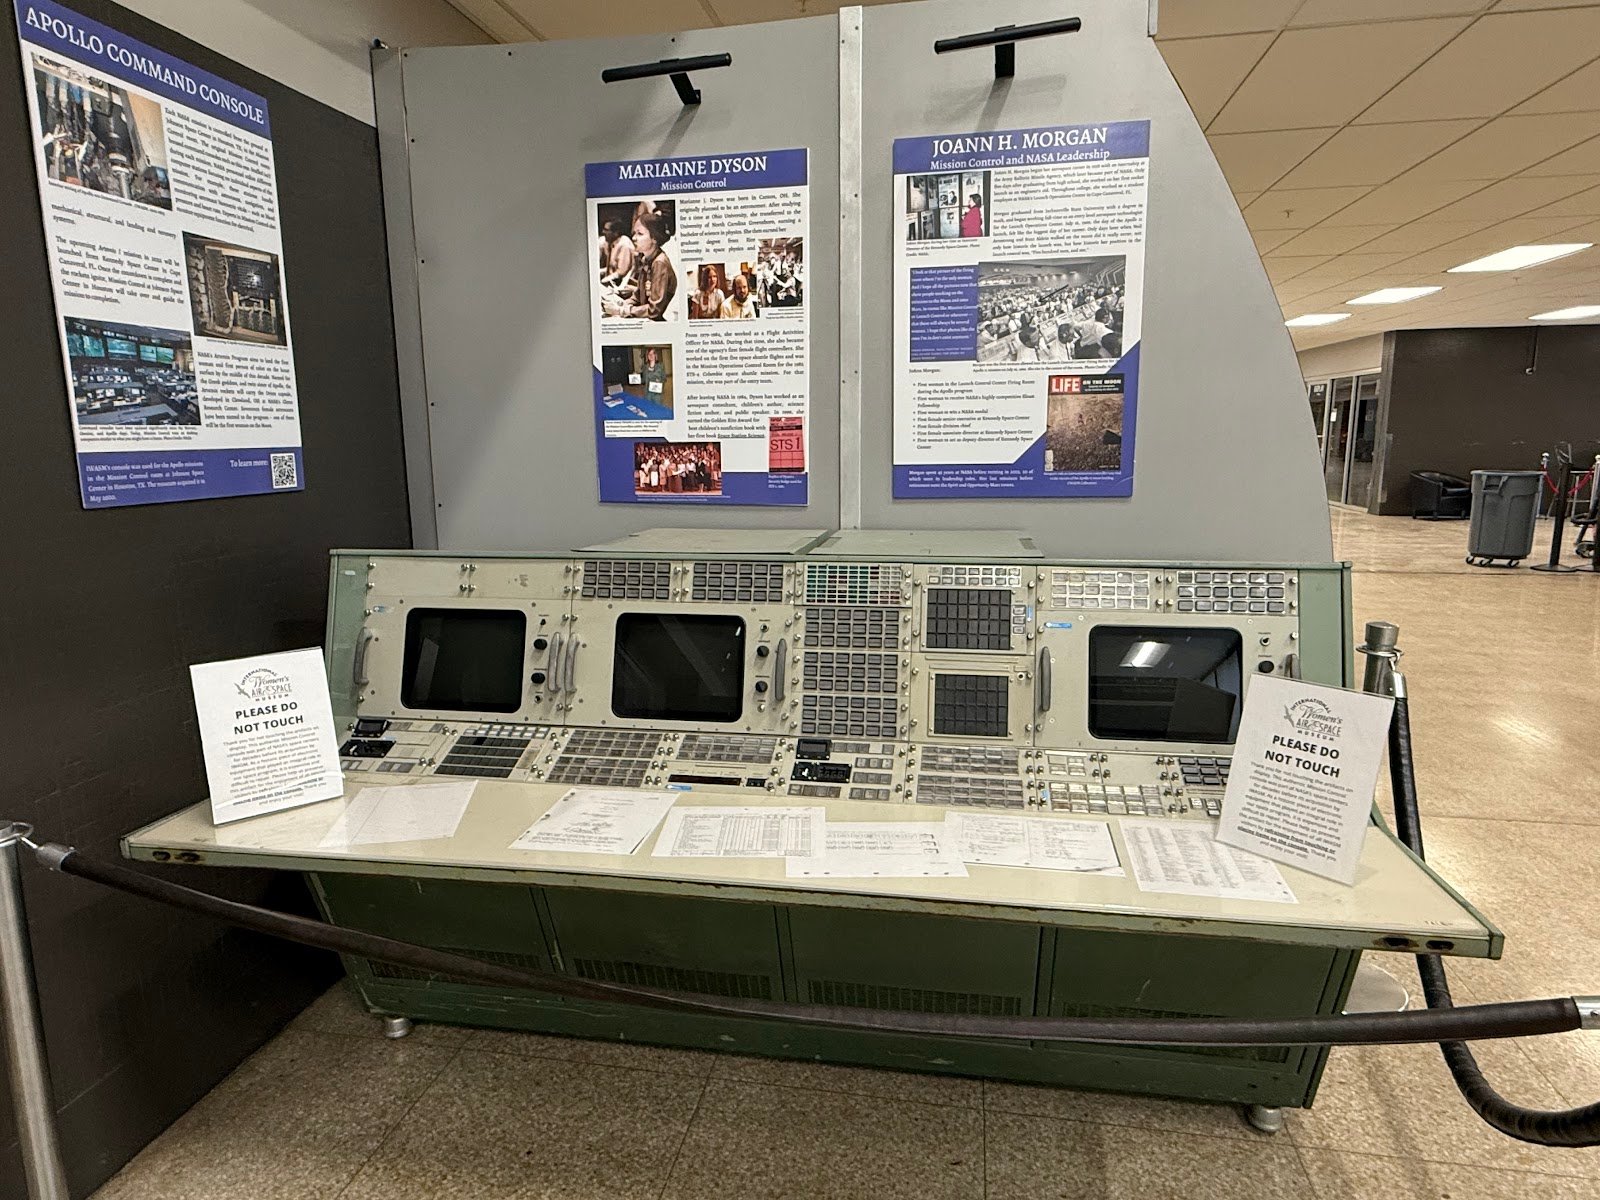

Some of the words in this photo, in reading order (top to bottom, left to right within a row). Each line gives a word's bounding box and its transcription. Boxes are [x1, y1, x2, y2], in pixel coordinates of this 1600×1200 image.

[26, 7, 103, 54] APOLLO
[107, 43, 196, 95] COMMAND
[199, 84, 264, 125] CONSOLE
[932, 137, 992, 158] JOANN
[997, 134, 1017, 150] H.
[1022, 127, 1108, 148] MORGAN
[619, 159, 707, 180] MARIANNE
[710, 156, 768, 175] DYSON
[930, 161, 966, 170] Mission
[968, 156, 1004, 167] Control
[1006, 154, 1024, 165] and
[1026, 153, 1054, 163] NASA
[1056, 149, 1110, 162] Leadership
[661, 181, 693, 191] Mission
[695, 178, 726, 189] Control
[1051, 378, 1080, 392] LIFE
[770, 439, 793, 450] STS
[796, 437, 799, 449] 1
[238, 459, 252, 467] learn
[236, 704, 278, 719] PLEASE
[281, 702, 298, 712] DO
[1299, 704, 1343, 724] Women's
[234, 722, 259, 734] NOT
[263, 715, 303, 729] TOUCH
[1319, 723, 1342, 737] SPACE
[1297, 730, 1334, 741] MUSEUM
[1272, 735, 1317, 754] PLEASE
[1320, 746, 1340, 759] DO
[1265, 750, 1292, 765] NOT
[1295, 757, 1340, 778] TOUCH
